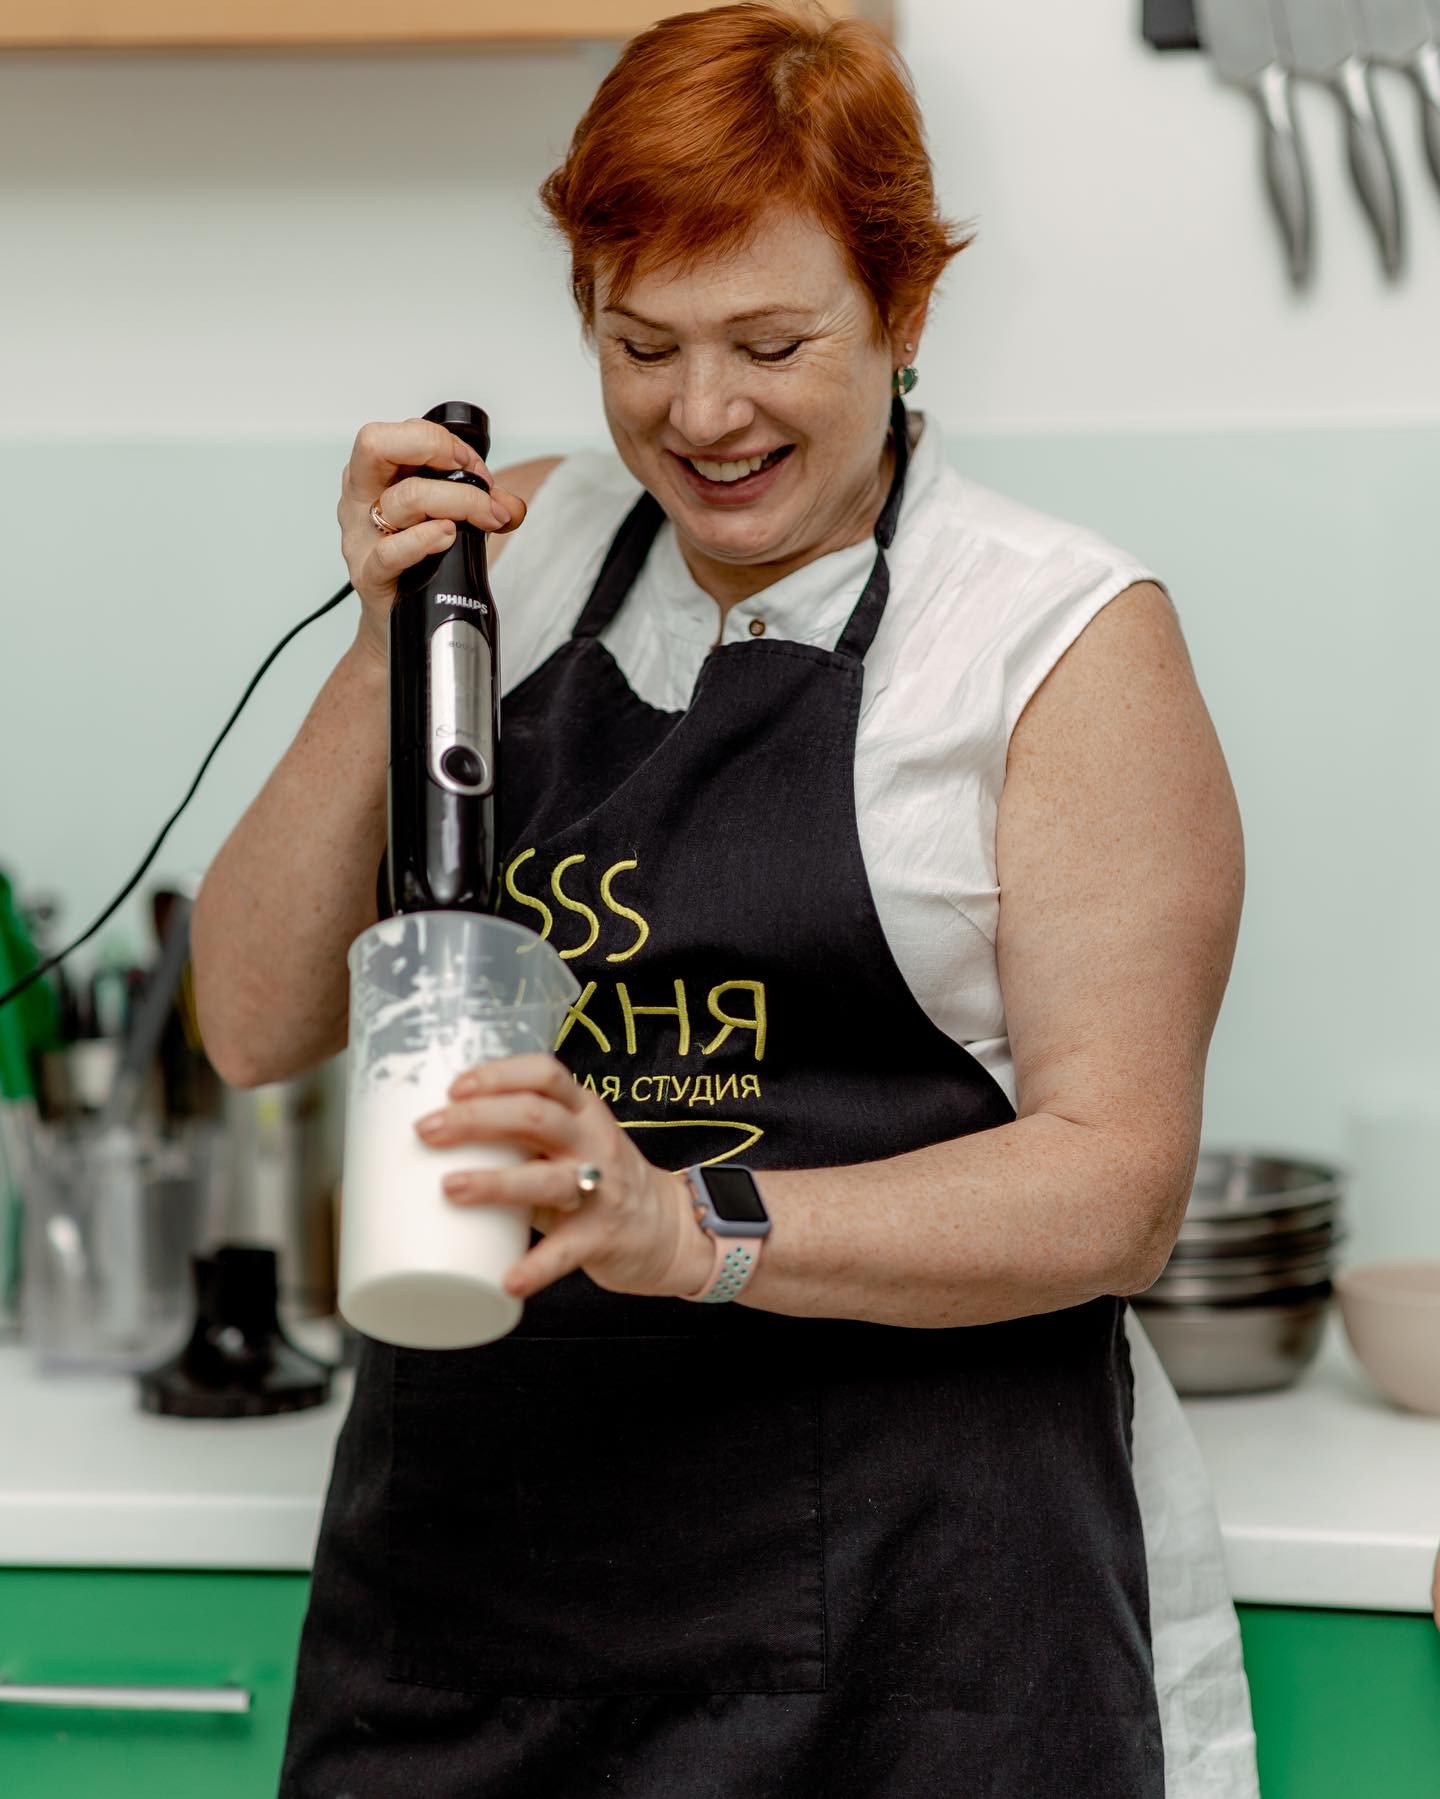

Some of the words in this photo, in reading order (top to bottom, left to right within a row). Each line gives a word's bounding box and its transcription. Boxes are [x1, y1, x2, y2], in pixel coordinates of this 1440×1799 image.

[435, 593, 488, 615] PHILIPS
[495, 847, 650, 962] SSS
[631, 1073, 762, 1107] СТУДИЯ
